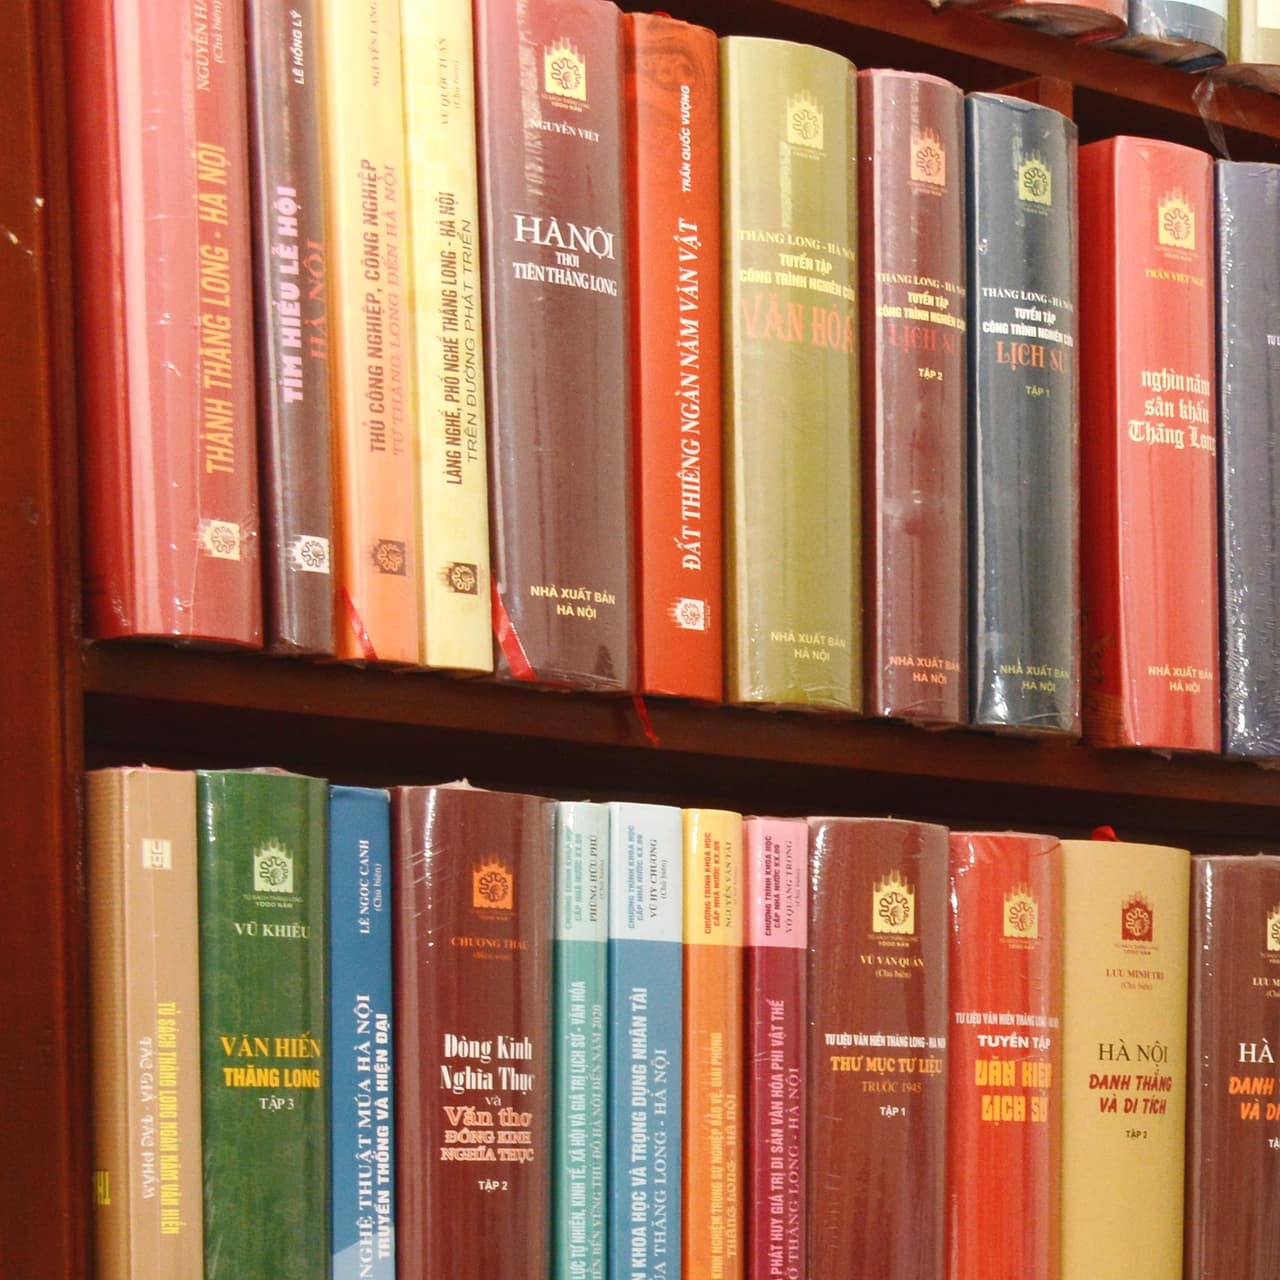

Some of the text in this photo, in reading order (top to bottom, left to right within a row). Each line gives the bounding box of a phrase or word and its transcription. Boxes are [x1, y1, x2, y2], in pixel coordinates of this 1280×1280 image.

[275, 185, 301, 237] HỘI
[438, 191, 457, 217] NỘI
[439, 221, 456, 239] HÀ
[441, 251, 458, 286] LONG
[589, 273, 617, 296] LONG
[195, 141, 234, 473] THÀNH THĂNG LONG HÀ NỘI
[271, 282, 300, 348] HIỂU
[438, 288, 459, 333] THĂNG
[279, 356, 302, 403] TÌM
[437, 377, 460, 404] PHỐ
[673, 217, 702, 570] ĐẤT THIÊNG NGÀN NĂM VĂN VẬT
[442, 450, 463, 485] LÀNG
[530, 585, 558, 599] NHÀ
[561, 584, 592, 603] XUẤT
[556, 603, 597, 620] HÀ NỘI
[235, 921, 258, 938] VŨ
[628, 987, 647, 1012] TÀI
[375, 1013, 389, 1044] ĐẠI
[628, 1016, 647, 1060] NHÂN
[221, 1035, 270, 1058] VĂN
[1098, 1042, 1168, 1068] HÀ NỘI
[223, 1067, 320, 1089] THĂNG LONG
[372, 1050, 390, 1092] HIỆN
[650, 1049, 670, 1083] NỘI
[865, 1057, 895, 1075] MỤC
[631, 1064, 650, 1107] DỤNG
[1088, 1072, 1131, 1091] DANH
[259, 1096, 294, 1112] TẬP 3
[372, 1097, 389, 1120] VÀ
[651, 1089, 666, 1115] HÀ
[880, 1105, 905, 1118] TẬP 1
[1099, 1094, 1166, 1115] VÀ DI TÍCH
[352, 993, 376, 1279] NGHỆ THUẬT MÚA HÀ NỘI
[497, 1131, 532, 1143] KINH
[631, 1112, 651, 1163] TRỌNG
[1142, 1130, 1148, 1140] 2
[654, 1131, 667, 1184] LONG
[477, 1179, 509, 1193] TẬP 2
[628, 1166, 647, 1187] VÀ
[631, 1191, 650, 1222] HỌC
[649, 1185, 667, 1257] THĂNG
[631, 1226, 647, 1268] KHOA
